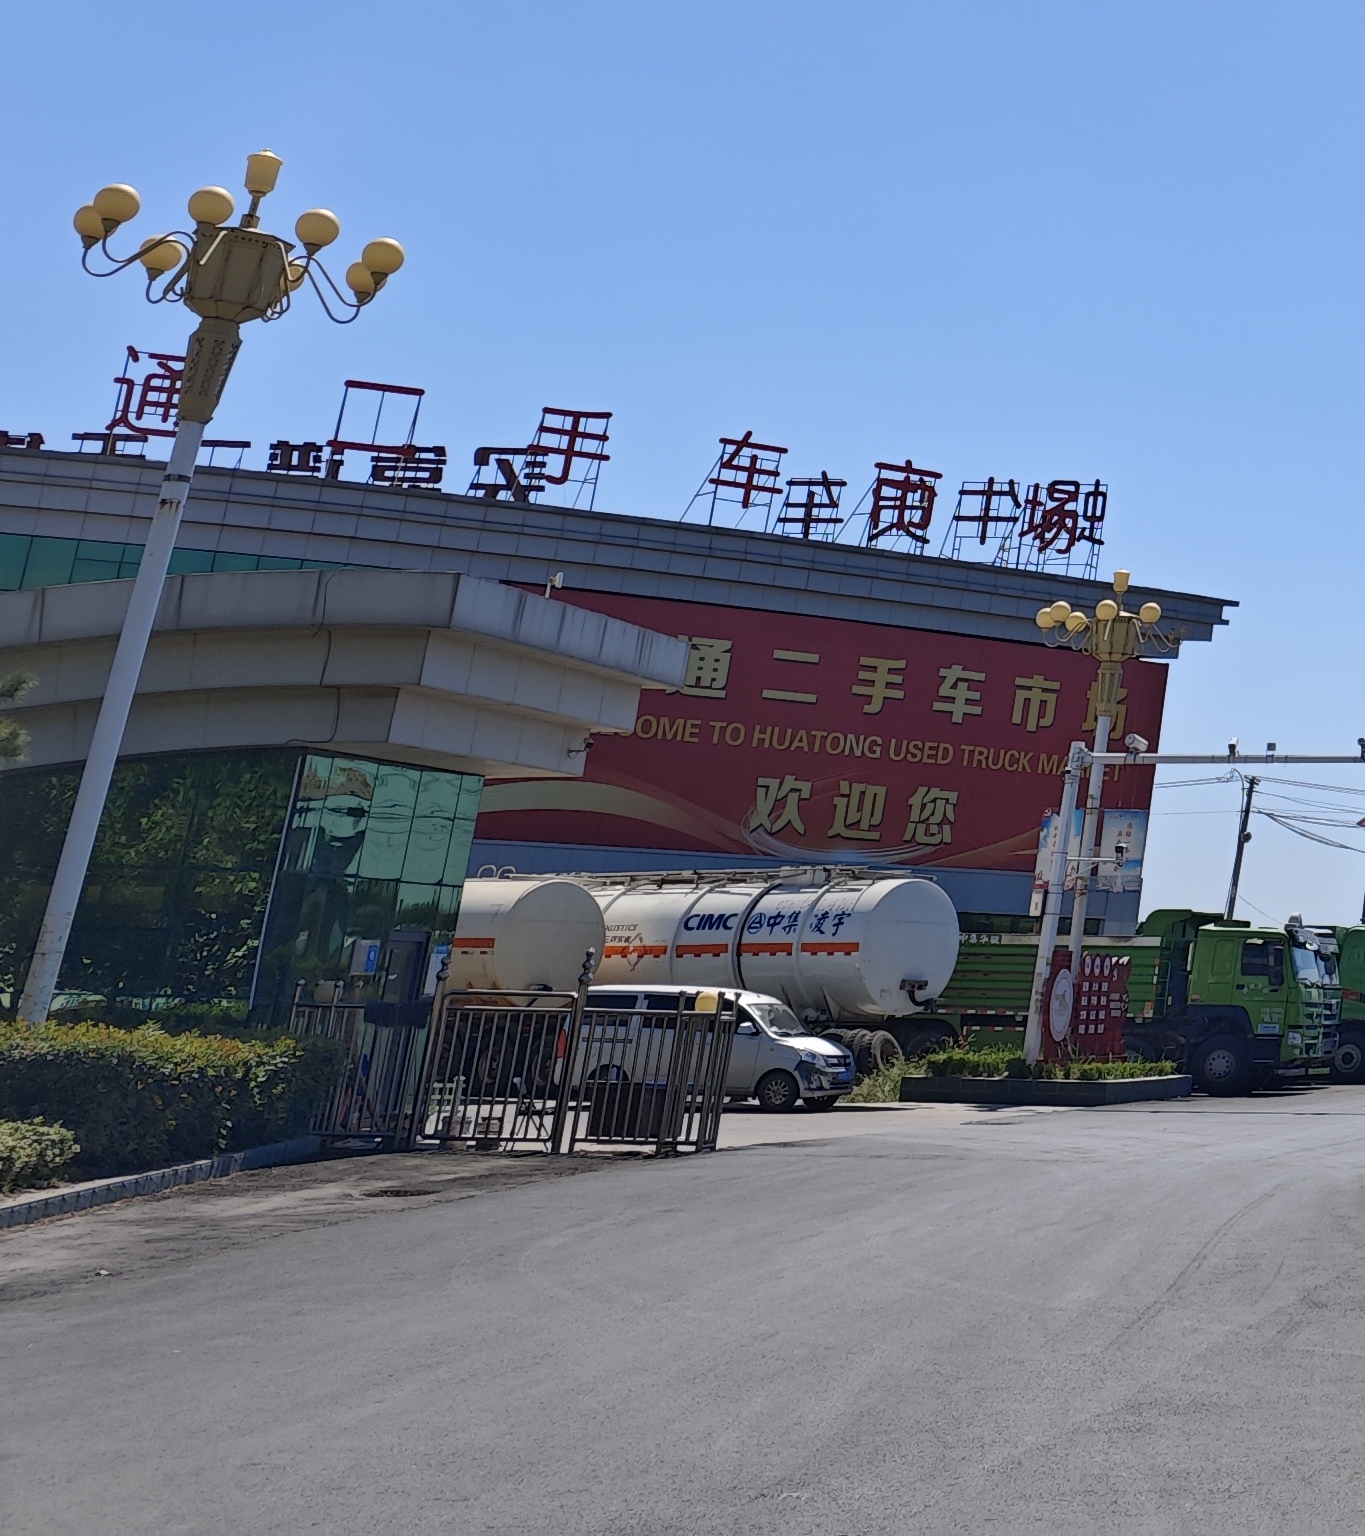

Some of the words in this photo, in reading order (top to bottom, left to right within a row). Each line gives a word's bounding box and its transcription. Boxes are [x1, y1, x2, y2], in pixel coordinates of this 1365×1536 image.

[709, 720, 746, 746] TO
[751, 724, 882, 759] HUATONG
[888, 737, 954, 765] USED
[959, 744, 1034, 773] TRUCK
[749, 774, 958, 845] 欢迎您
[683, 912, 740, 931] CIMC
